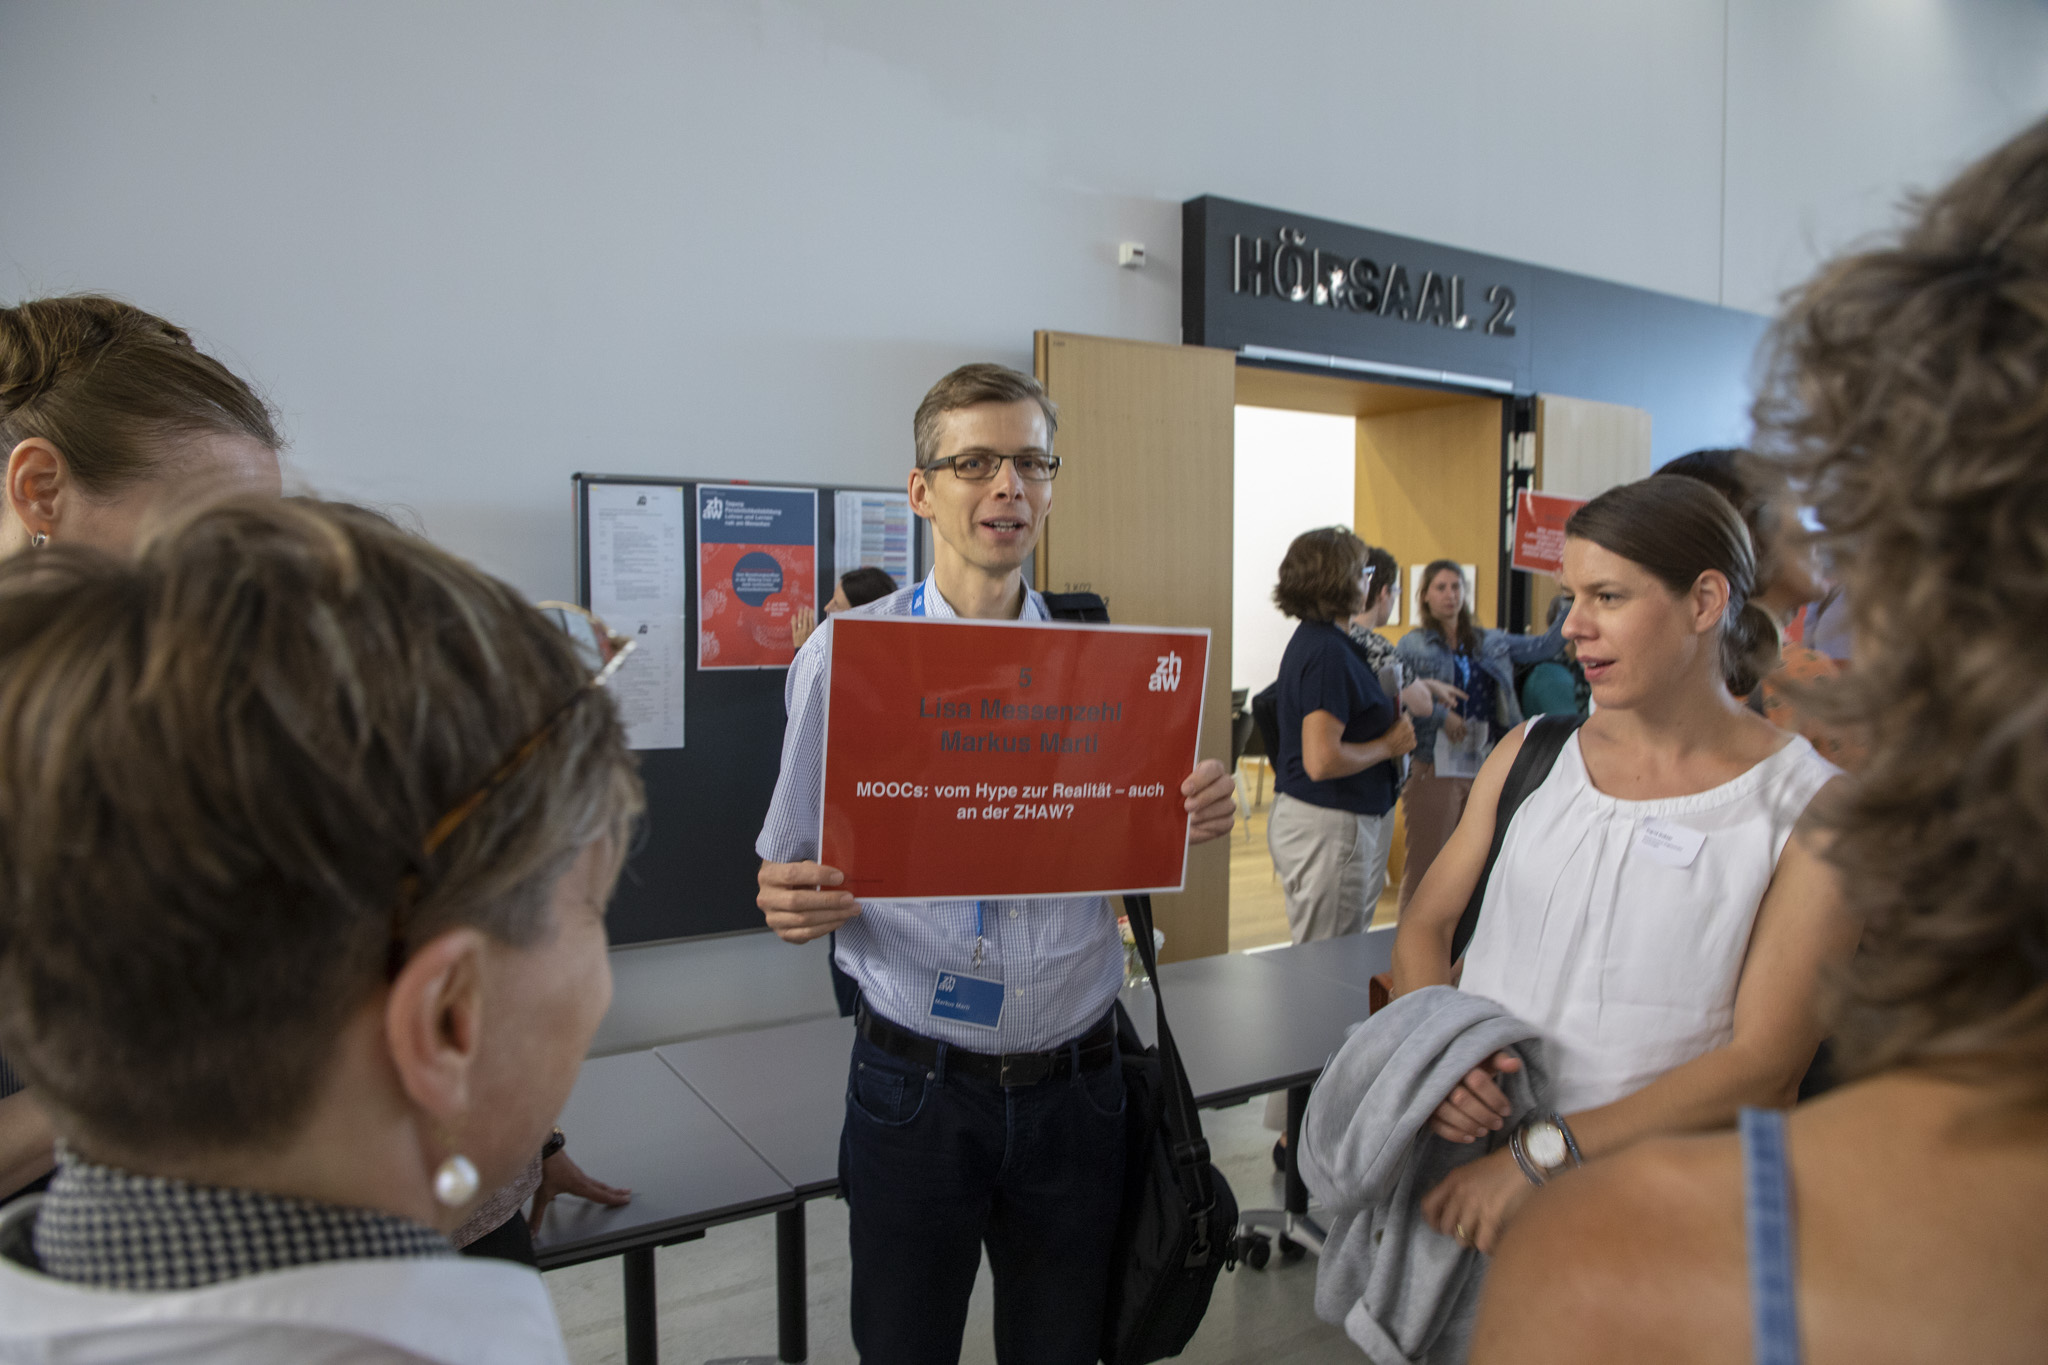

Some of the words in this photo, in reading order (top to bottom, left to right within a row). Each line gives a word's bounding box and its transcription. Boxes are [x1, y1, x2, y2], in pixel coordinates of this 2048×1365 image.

[1232, 226, 1473, 331] HÖRSAAL
[1485, 283, 1516, 337] 2
[1018, 667, 1033, 689] 5
[919, 697, 972, 719] Lisa
[980, 698, 1122, 722] Messenzehl
[940, 730, 1032, 752] Markus
[1040, 732, 1099, 753] Marti
[856, 781, 929, 798] MOOCs:
[934, 785, 971, 798] vom
[975, 782, 1018, 802] Hype
[1022, 785, 1048, 798] zur
[1052, 782, 1112, 799] Realität
[1128, 782, 1165, 798] auch
[956, 806, 978, 820] an
[982, 804, 1010, 820] der
[1013, 803, 1075, 820] ZHAW?
